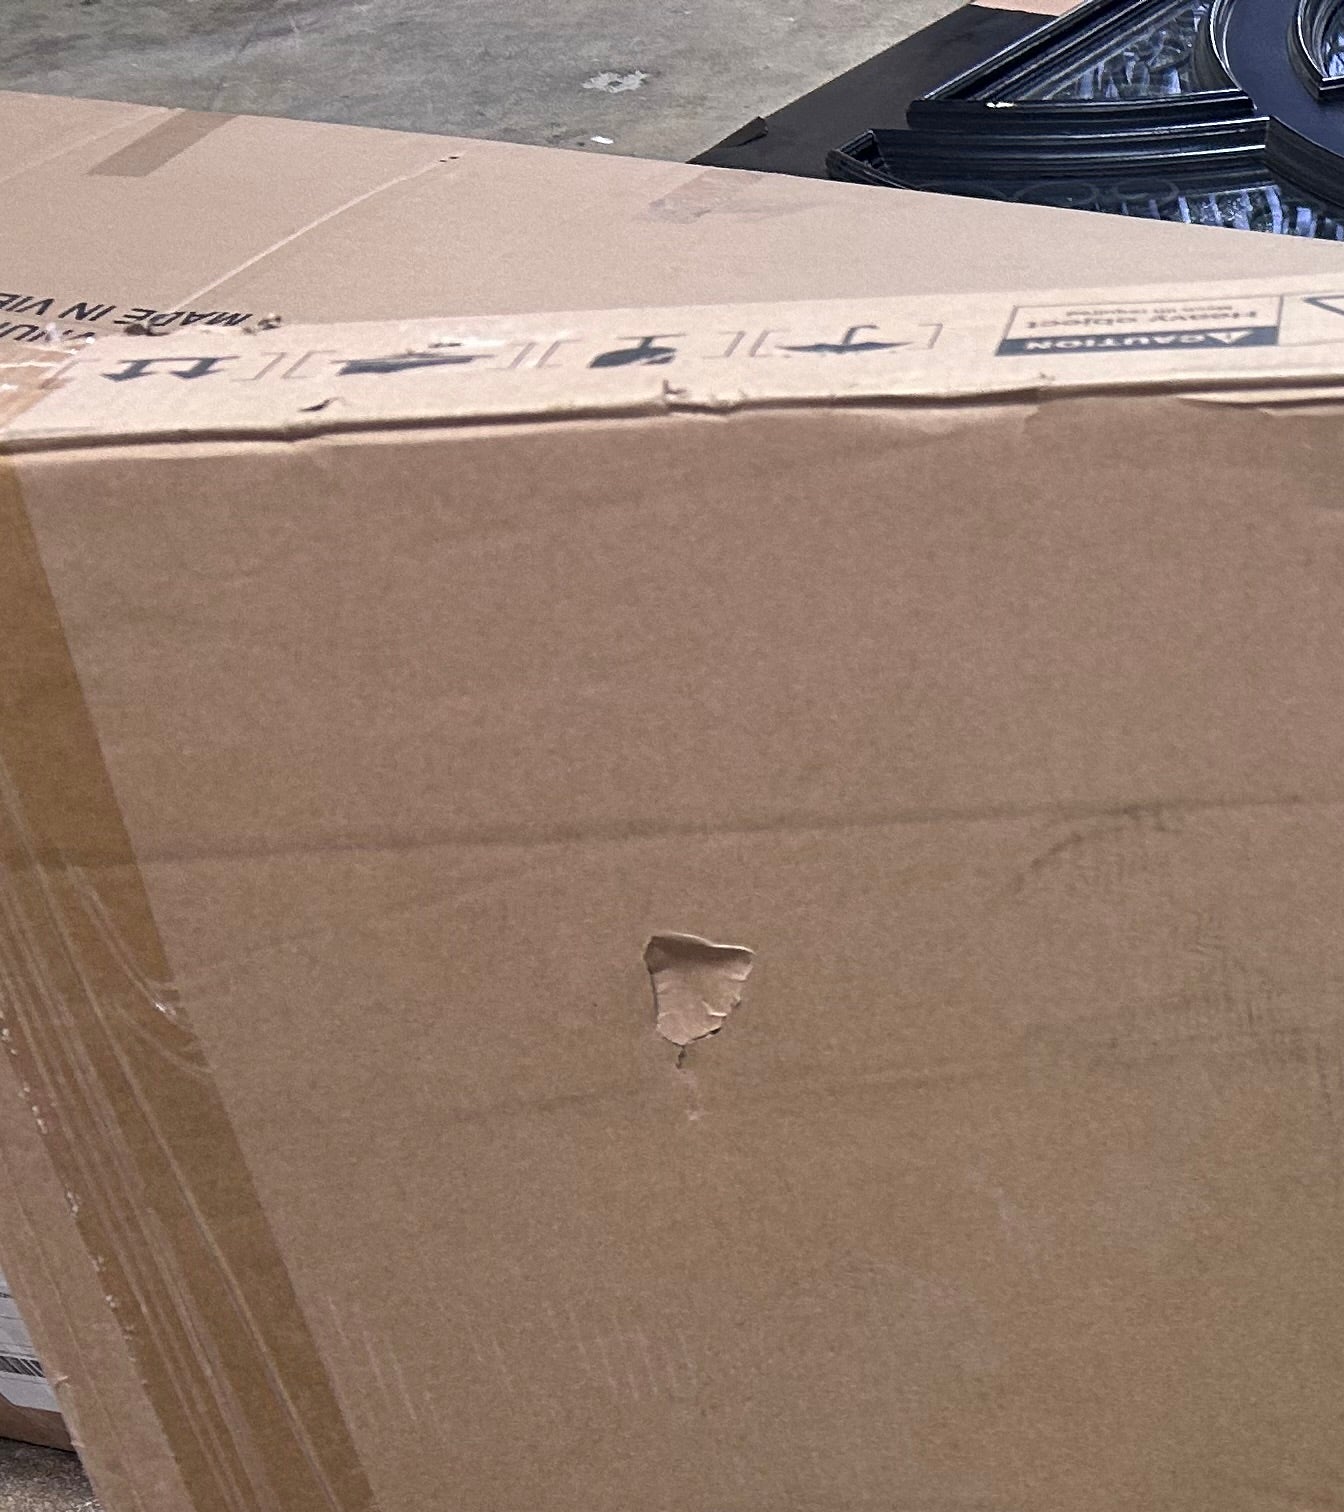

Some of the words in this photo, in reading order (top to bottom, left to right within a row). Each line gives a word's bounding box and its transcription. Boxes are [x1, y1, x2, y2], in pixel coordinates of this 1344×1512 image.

[57, 302, 117, 322] IN
[114, 308, 253, 327] MADE
[1025, 332, 1207, 351] CAUTION
